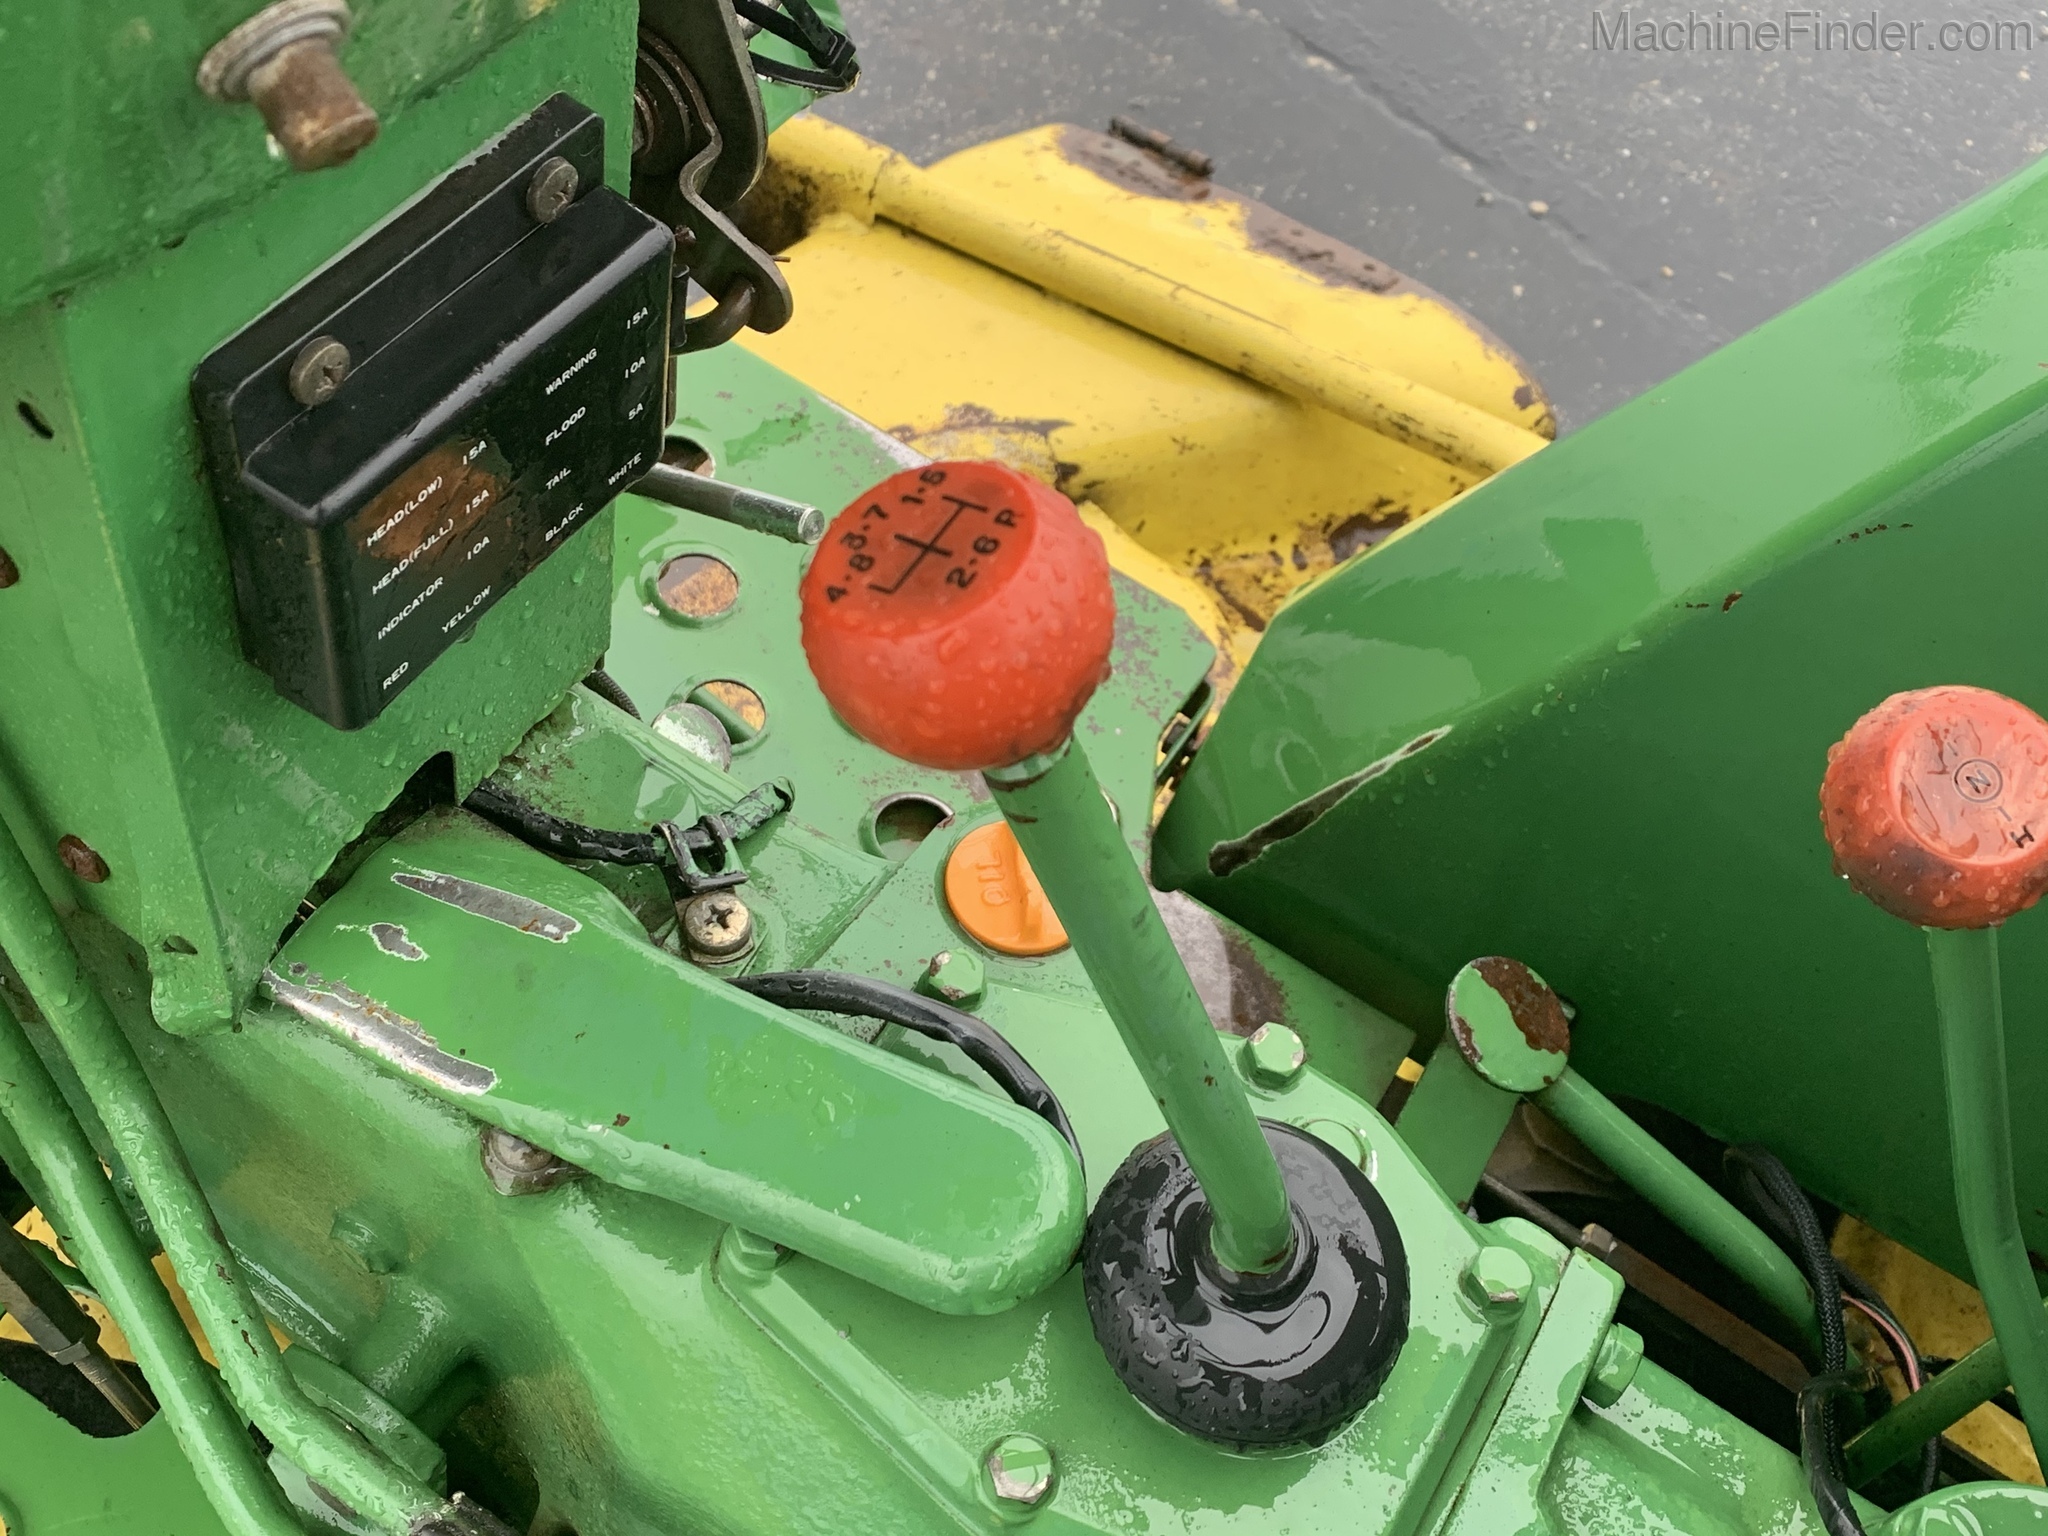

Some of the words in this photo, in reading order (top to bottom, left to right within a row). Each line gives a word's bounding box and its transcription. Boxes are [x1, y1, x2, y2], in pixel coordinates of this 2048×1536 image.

[545, 348, 597, 395] WARNING
[627, 307, 649, 329] 15A
[545, 406, 586, 446] FLOOD
[625, 356, 646, 378] 10A
[546, 467, 571, 490] TAIL
[628, 402, 644, 420] 5A
[366, 476, 443, 547] HEAD(LOW)
[463, 440, 487, 465] 15A
[545, 503, 584, 542] BLACK
[608, 452, 642, 485] WHITE
[372, 518, 454, 595] HEAD(FULL)
[465, 489, 490, 514] 15A
[378, 577, 444, 640] INDICATOR
[467, 536, 490, 560] 10A
[383, 661, 409, 690] RED
[441, 585, 492, 634] YELLOW
[1966, 769, 1991, 794] N
[976, 851, 1011, 906] OIL
